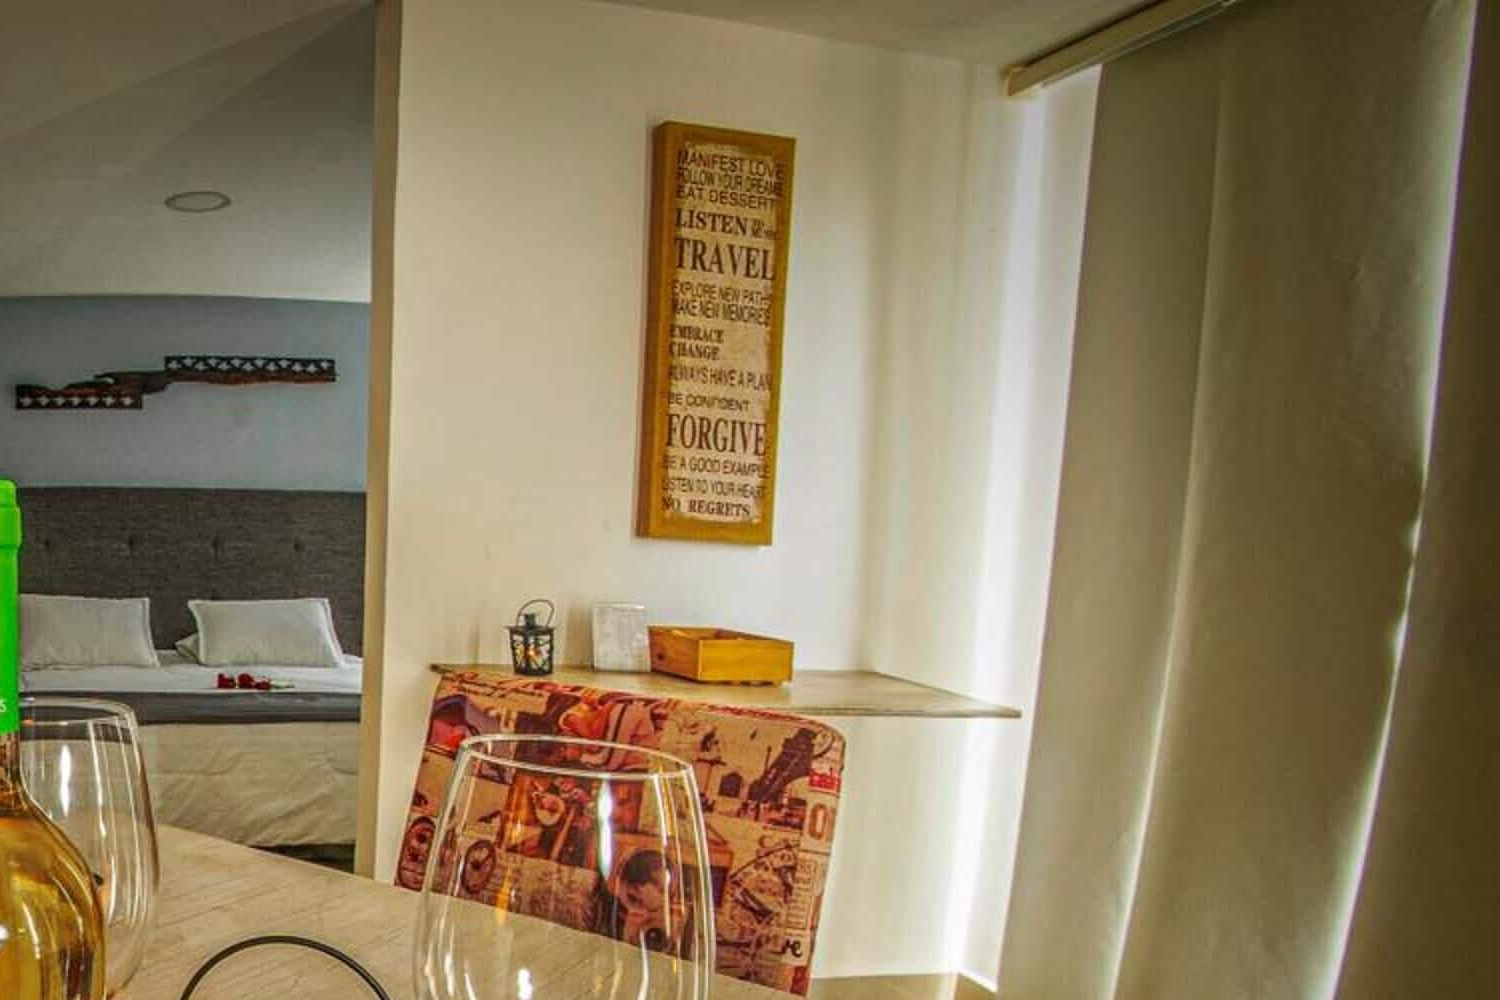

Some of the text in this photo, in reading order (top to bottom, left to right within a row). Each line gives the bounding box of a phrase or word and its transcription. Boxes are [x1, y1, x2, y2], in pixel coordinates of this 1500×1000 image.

[676, 149, 744, 173] MANIFEST
[676, 184, 778, 211] EAT DESSERT
[675, 207, 749, 236] LISTEN
[674, 237, 775, 281] TRAVEL
[669, 323, 725, 344] EMBRACE
[668, 341, 720, 361] CHANGE
[667, 391, 750, 412] BE CONFIDENT
[666, 413, 766, 457] FORGIVE
[663, 454, 677, 470] BE
[688, 456, 720, 473] GOOD
[722, 459, 771, 479] EXAMPLE
[661, 477, 693, 493] LISTEN
[661, 495, 751, 517] NO REGRETS
